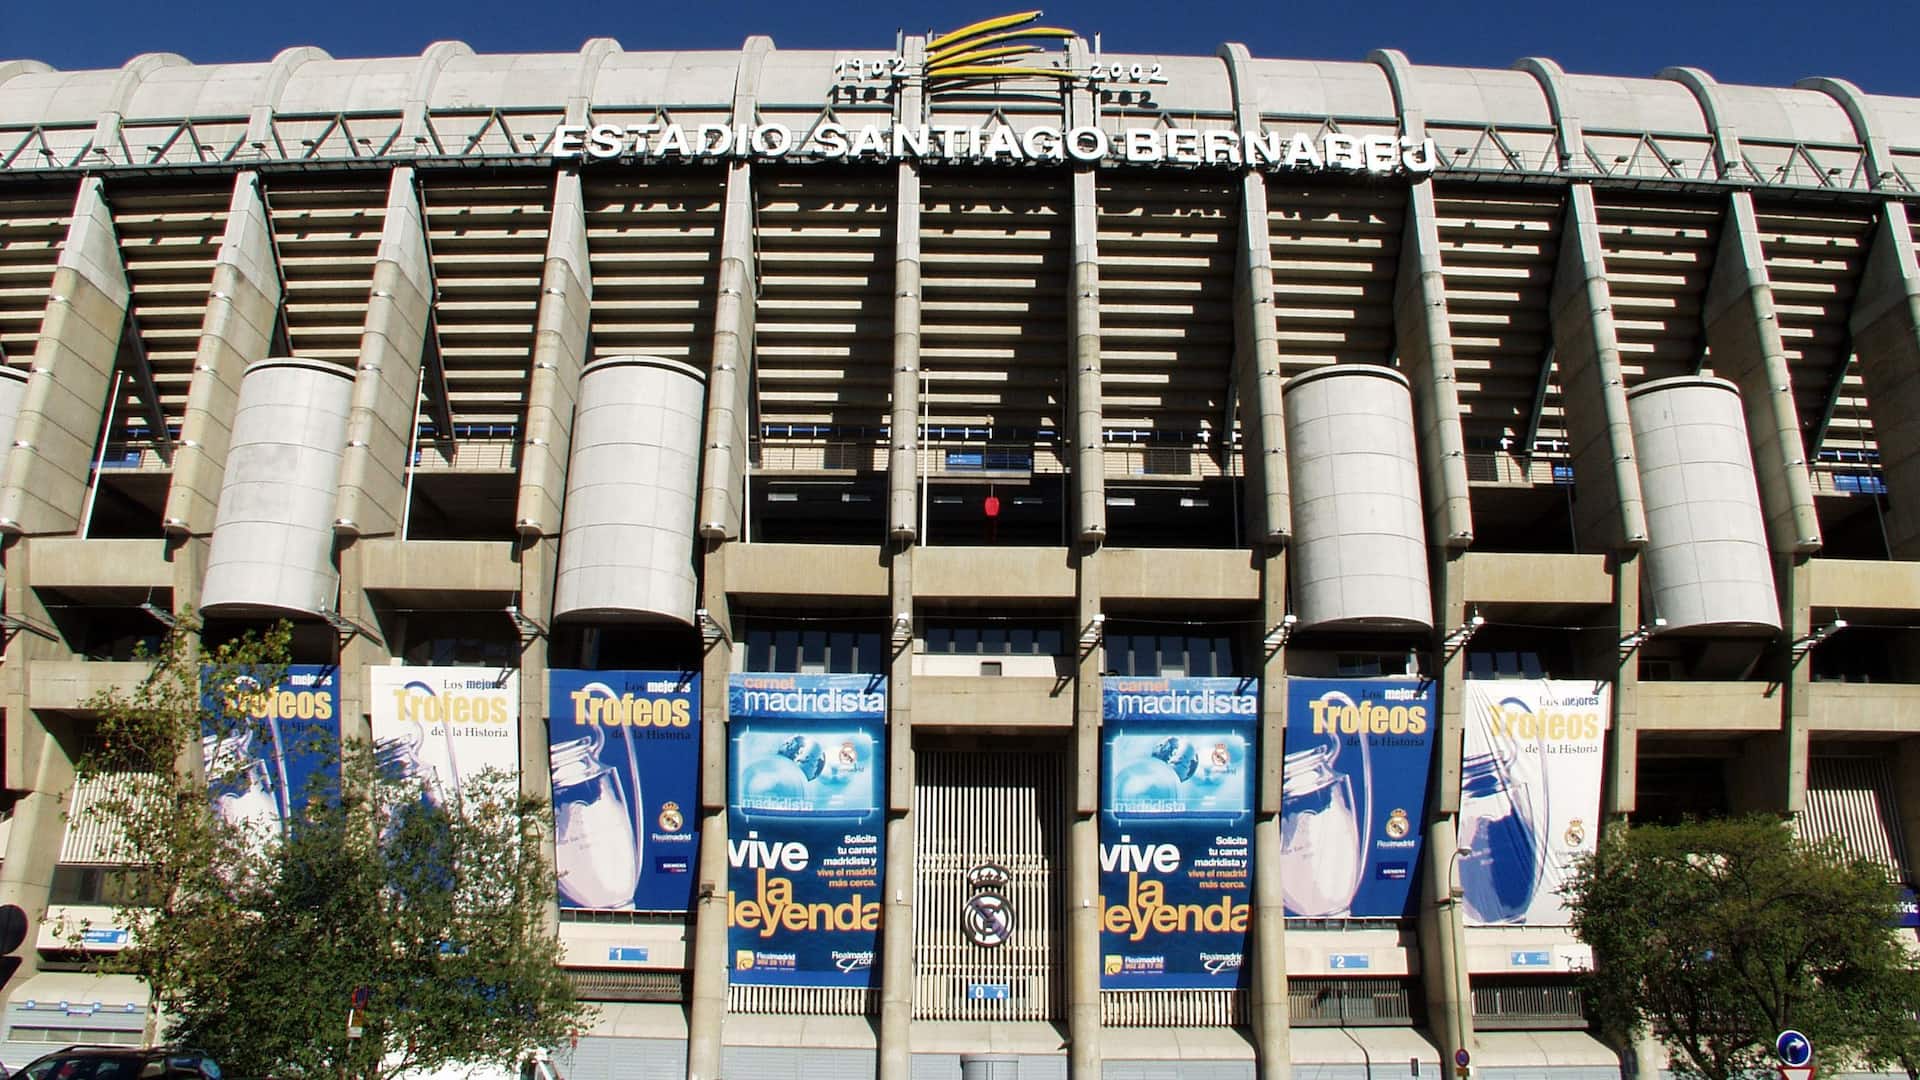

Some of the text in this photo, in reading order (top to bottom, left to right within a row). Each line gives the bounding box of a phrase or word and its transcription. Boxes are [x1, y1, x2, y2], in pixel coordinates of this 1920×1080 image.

[835, 57, 910, 82] 1902
[1090, 62, 1168, 85] 2002
[552, 123, 1436, 171] ESTADIO SANTIAGO BERNABEU
[443, 679, 507, 691] Los mejors
[1384, 687, 1428, 701] mejors
[393, 688, 508, 724] Trofeos
[571, 691, 691, 728] Trofeos
[744, 688, 884, 712] madridista
[1117, 689, 1257, 714] madridista
[1539, 696, 1559, 706] Los
[1309, 700, 1427, 735] Trofeos
[1488, 704, 1599, 741] Trofeos
[431, 726, 508, 737] de la Historia
[1525, 743, 1598, 755] de la Historia
[837, 845, 877, 856] tu carnet
[843, 834, 877, 845] Solicita
[1215, 836, 1248, 846] Solicita
[728, 831, 809, 872] vive
[823, 856, 877, 868] madridista y
[1099, 835, 1181, 873] vive
[1208, 847, 1248, 857] tu carnet
[817, 868, 877, 877] vive el madrid
[1188, 870, 1248, 879] vive el madrid
[1194, 858, 1247, 869] madridista y
[757, 868, 793, 905] la
[1129, 872, 1164, 909] la
[728, 890, 881, 938] leyenda
[1098, 895, 1250, 942] leyenda
[1336, 956, 1345, 968] 2
